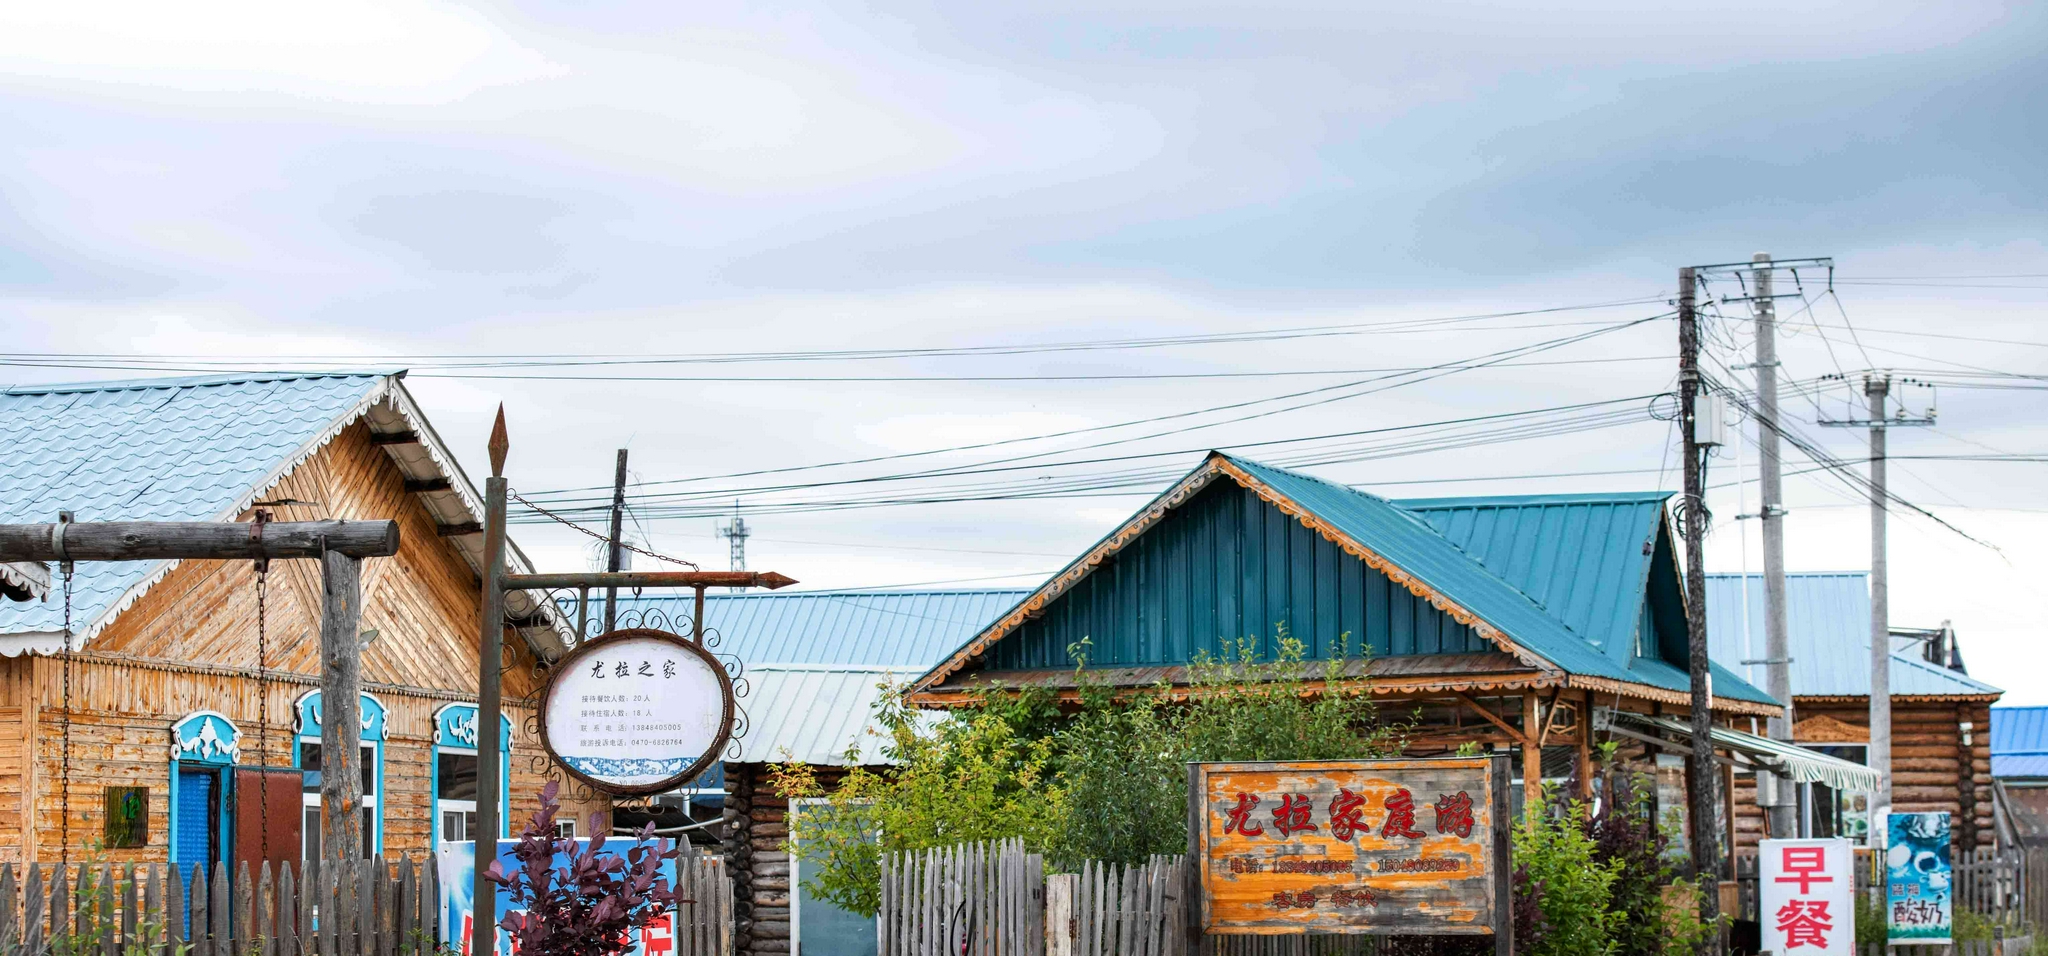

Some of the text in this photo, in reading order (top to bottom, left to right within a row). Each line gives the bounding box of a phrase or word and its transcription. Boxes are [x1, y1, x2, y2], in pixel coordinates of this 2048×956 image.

[591, 659, 676, 679] 尤拉之家
[1224, 787, 1476, 842] 尤拉家庭游
[1774, 847, 1833, 950] 早餐
[1894, 898, 1943, 924] 酸奶
